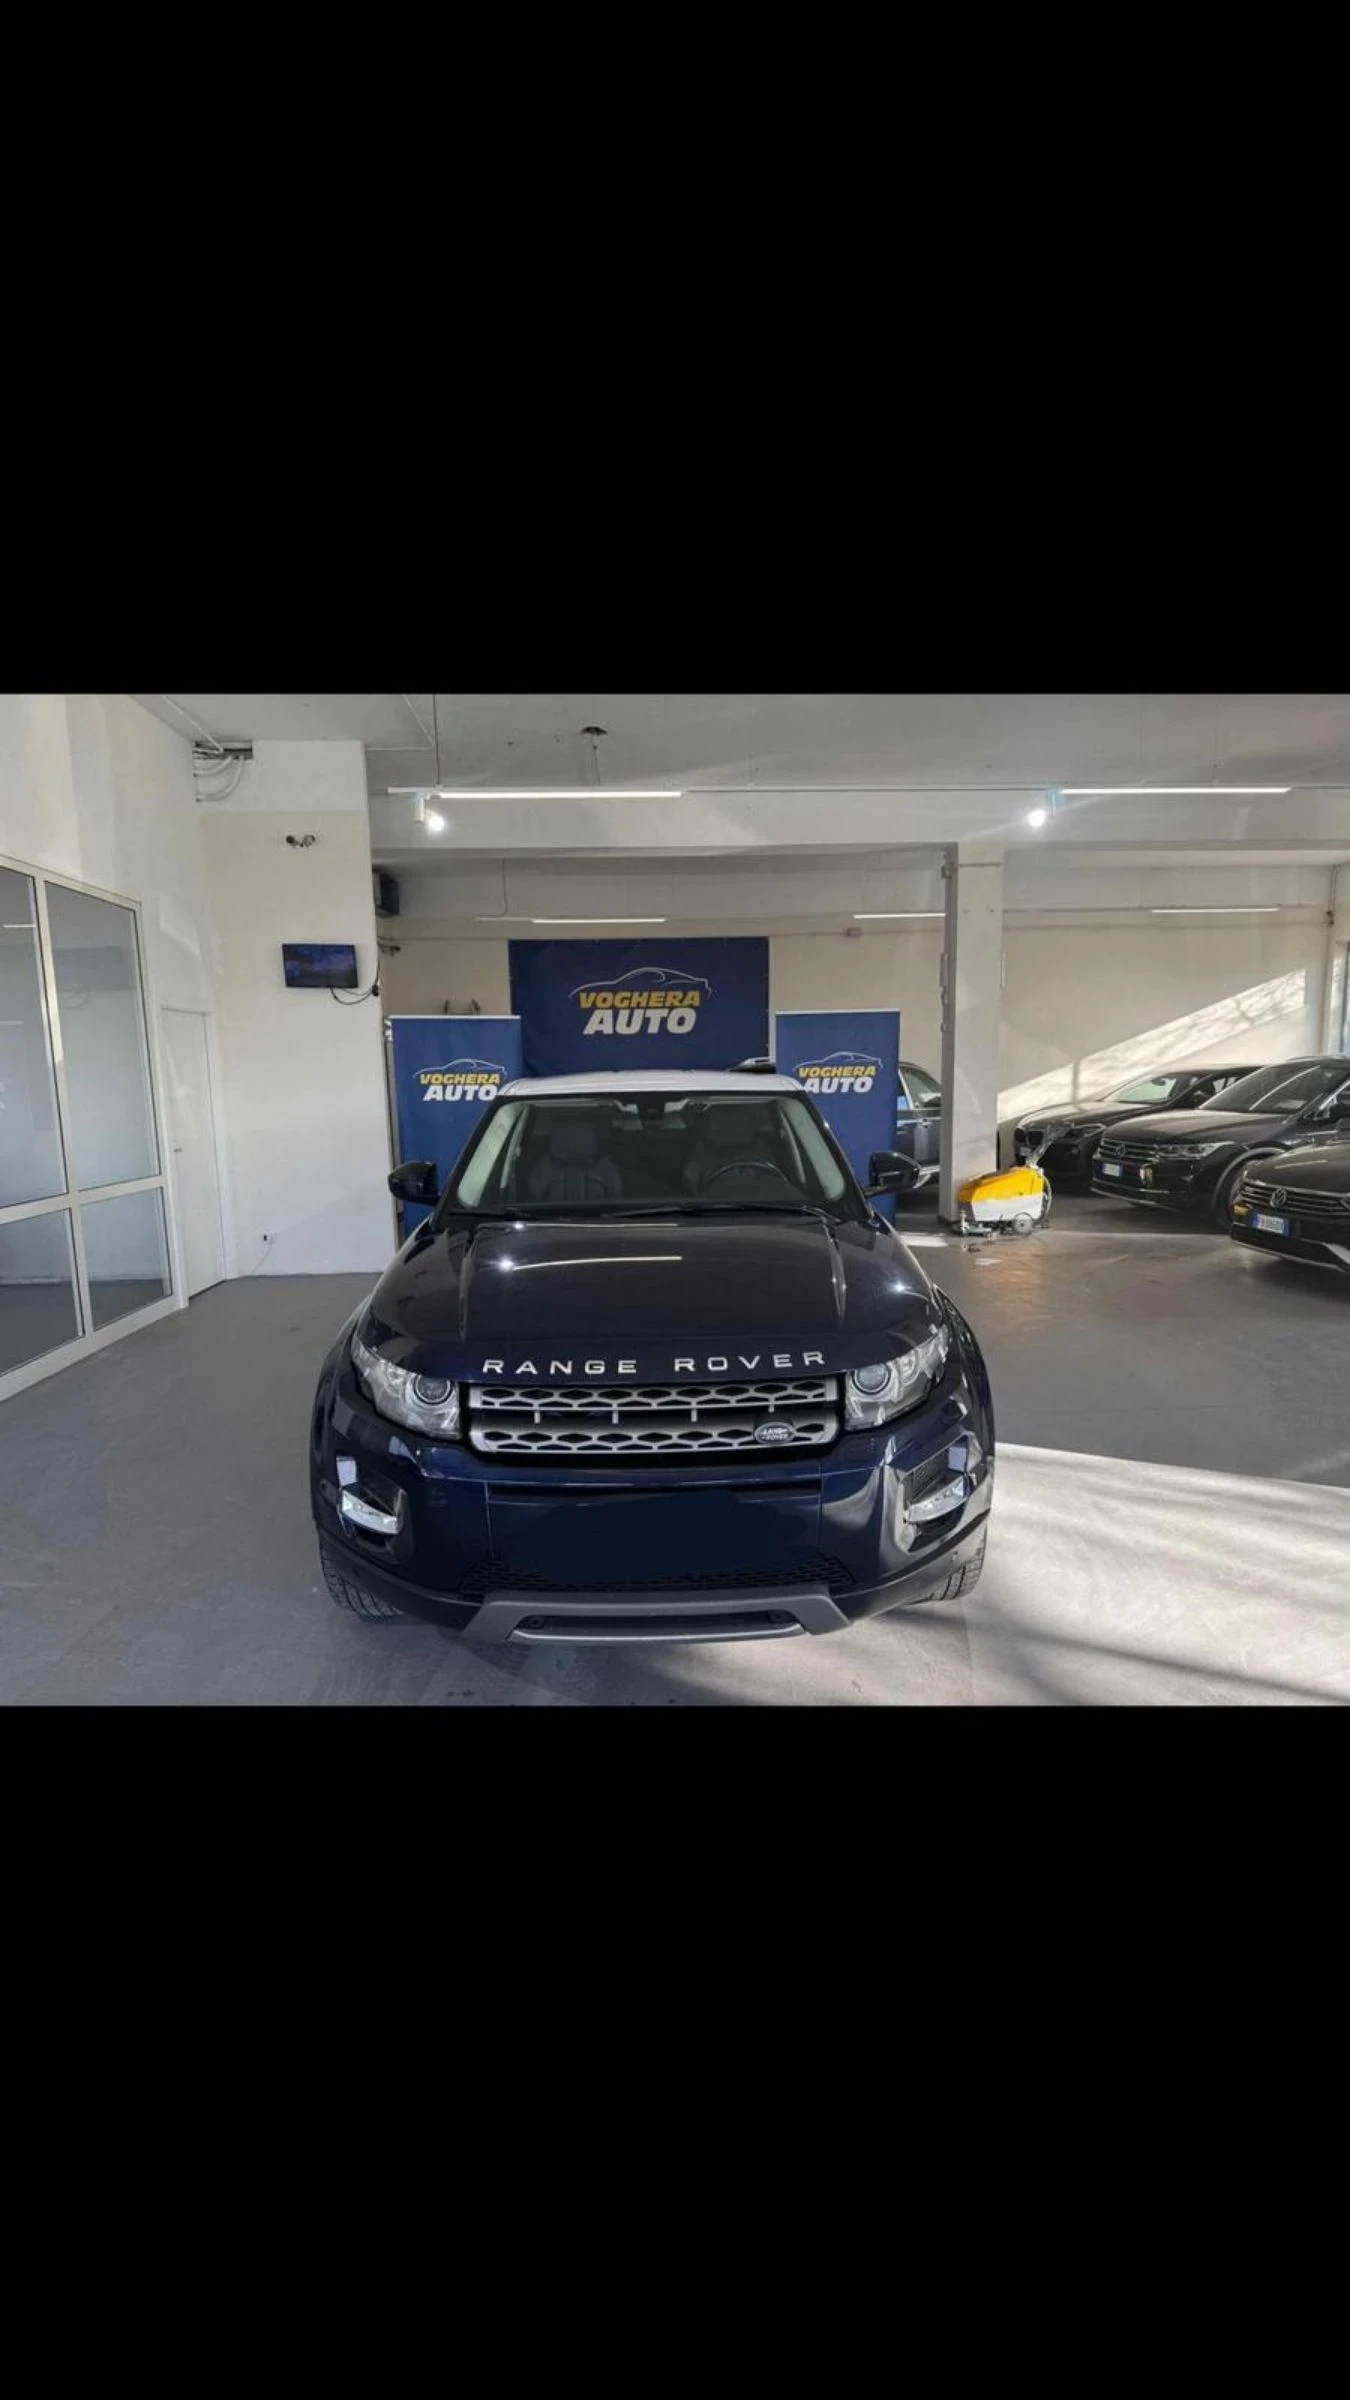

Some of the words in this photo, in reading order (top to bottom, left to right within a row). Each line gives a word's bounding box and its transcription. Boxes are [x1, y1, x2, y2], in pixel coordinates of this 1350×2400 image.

[579, 991, 700, 1009] VOGHERA
[582, 1008, 697, 1035] AUTO
[420, 1073, 500, 1085] VOGHERA
[799, 1066, 876, 1078] VOGHERA
[423, 1084, 498, 1102] AUTO
[804, 1077, 873, 1094] AUTO
[482, 1359, 637, 1375] RANGE
[674, 1351, 826, 1372] ROVER
